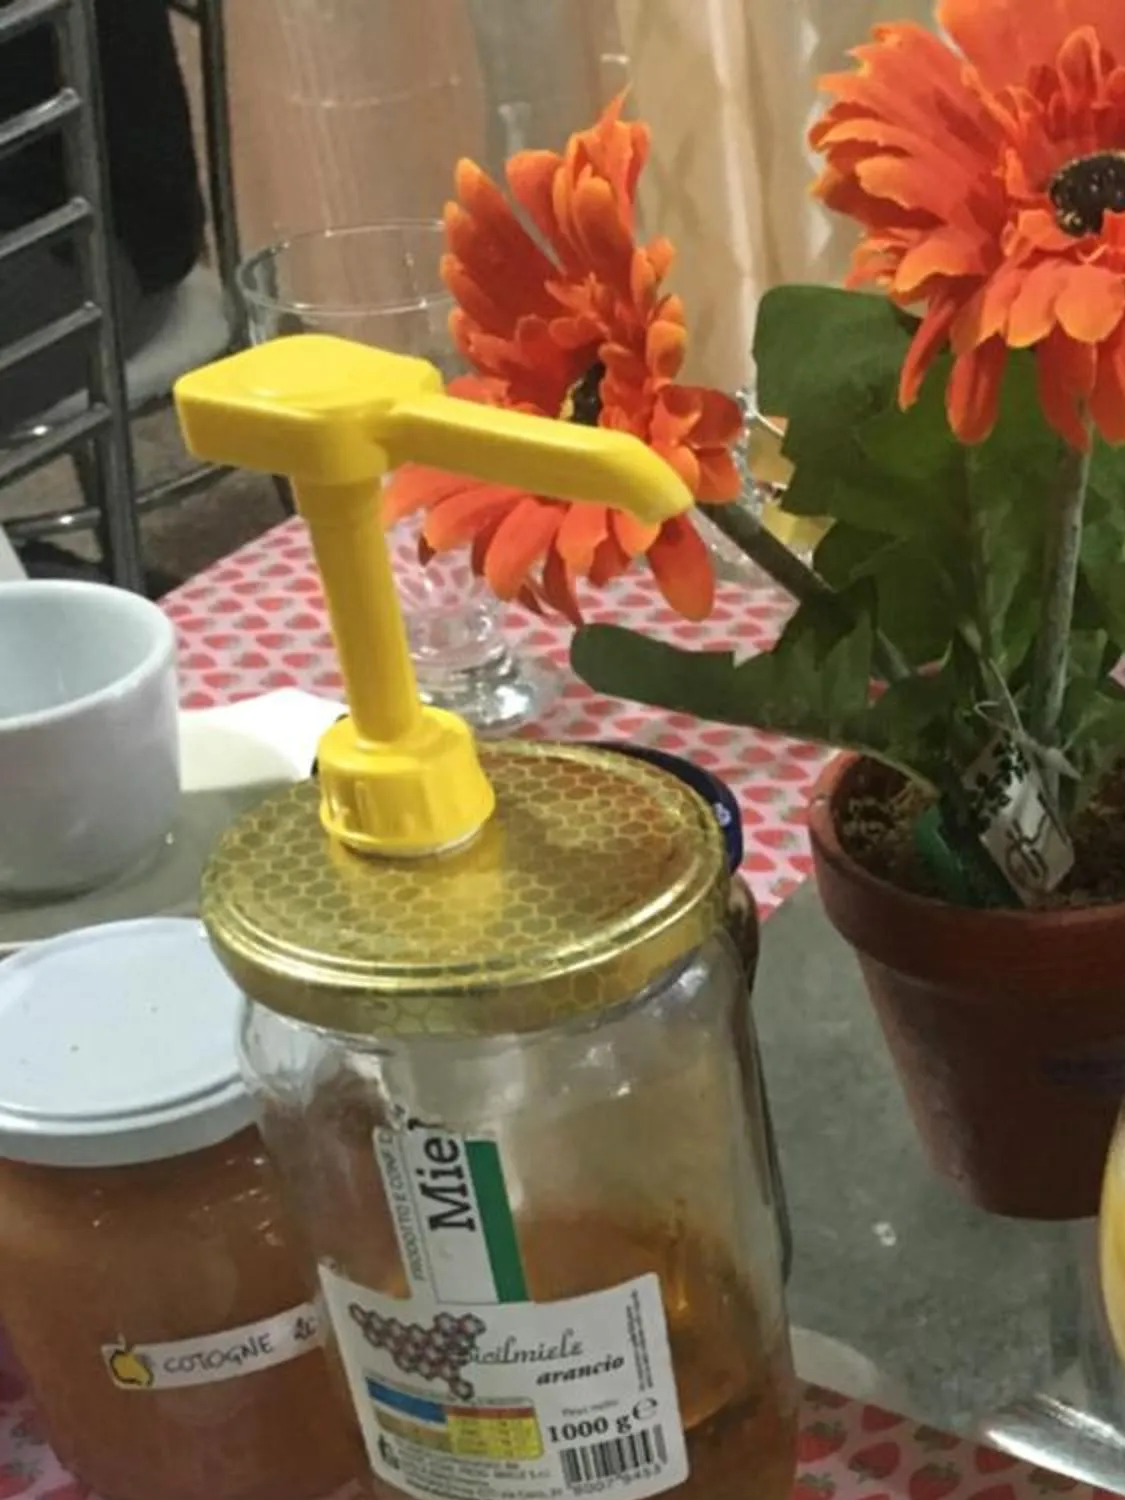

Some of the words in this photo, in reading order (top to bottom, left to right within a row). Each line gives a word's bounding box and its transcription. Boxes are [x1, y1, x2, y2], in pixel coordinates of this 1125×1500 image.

[163, 1333, 273, 1374] COTOGNE
[467, 1327, 583, 1365] icilmiele
[537, 1354, 625, 1385] arancio
[548, 1416, 608, 1443] 1000
